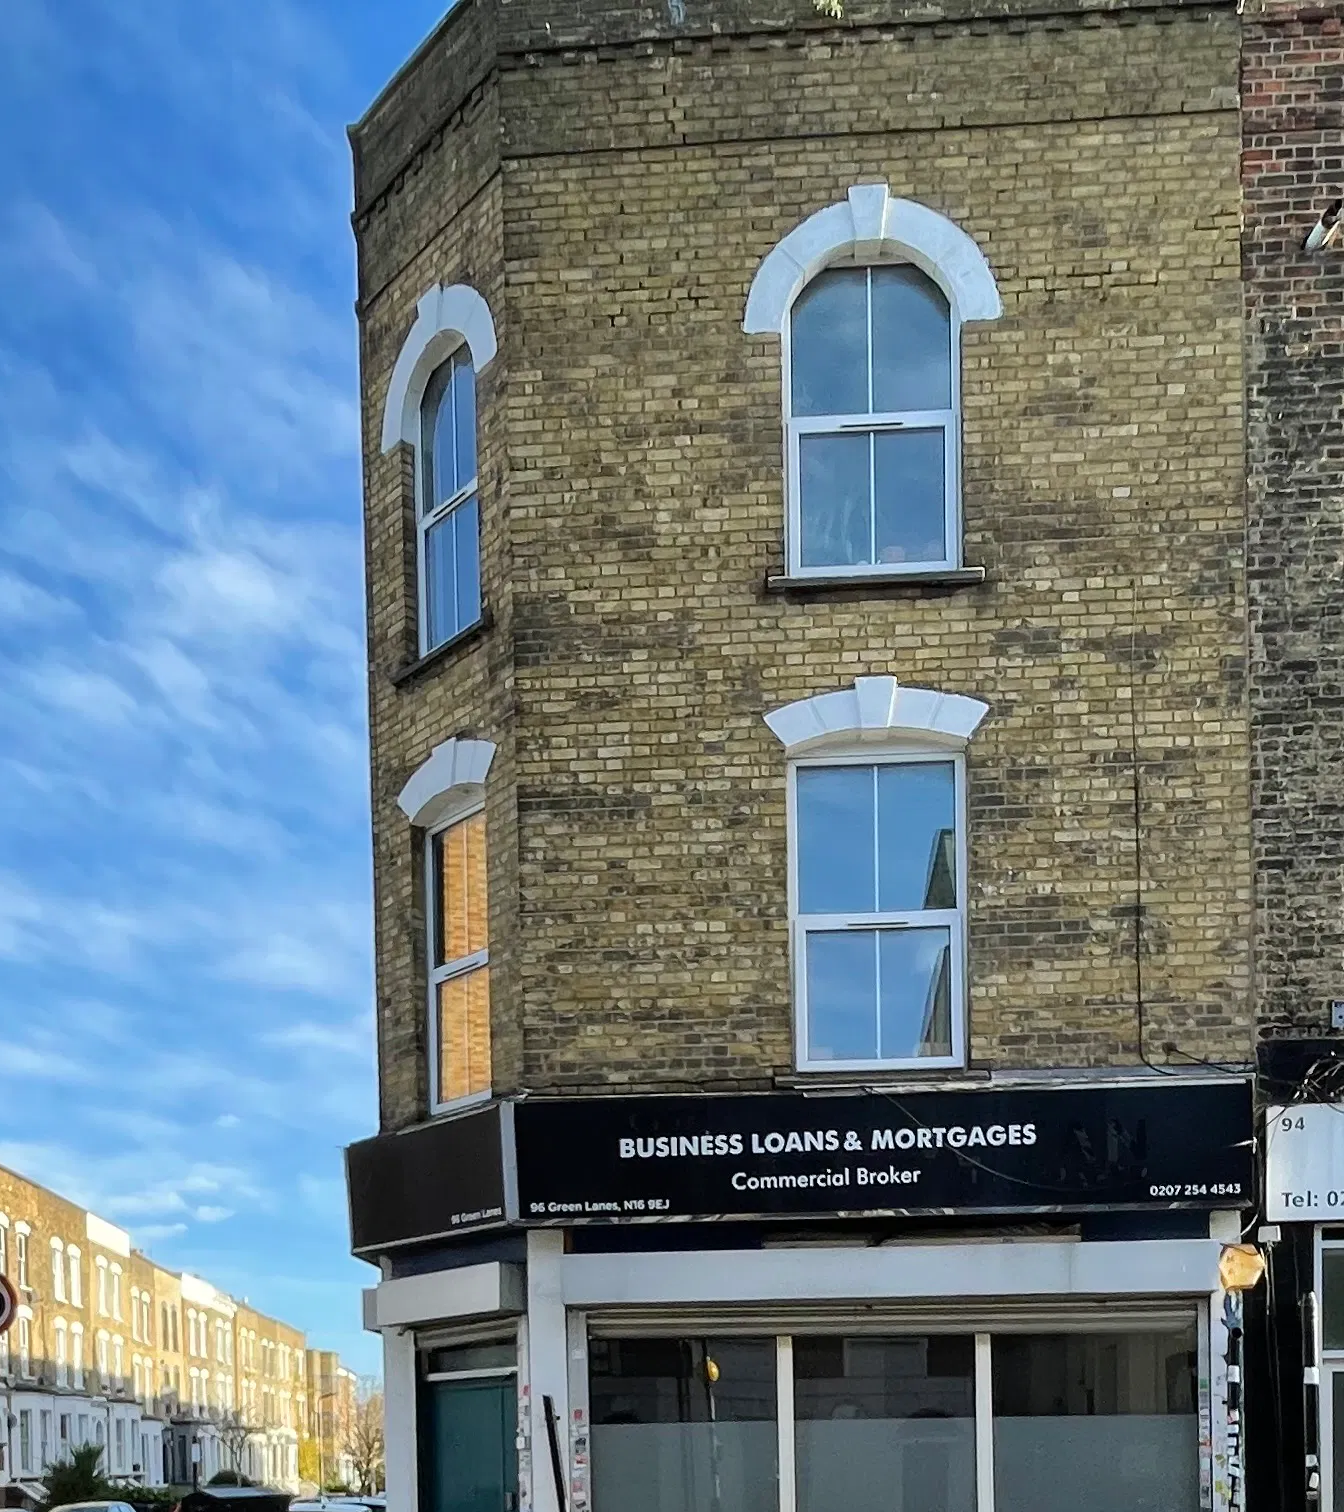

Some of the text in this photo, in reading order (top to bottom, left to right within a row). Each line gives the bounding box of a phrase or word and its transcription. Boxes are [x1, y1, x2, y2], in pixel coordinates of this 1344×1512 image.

[1281, 1116, 1306, 1132] 94
[619, 1123, 1037, 1159] BUSINESS LOANS & MORTGAGES
[731, 1164, 922, 1191] Commercial Broker
[1149, 1183, 1242, 1197] 0207 254 4543
[530, 1198, 670, 1213] 96 Green Lanes, N16 9EJ
[1281, 1190, 1319, 1208] Tel:
